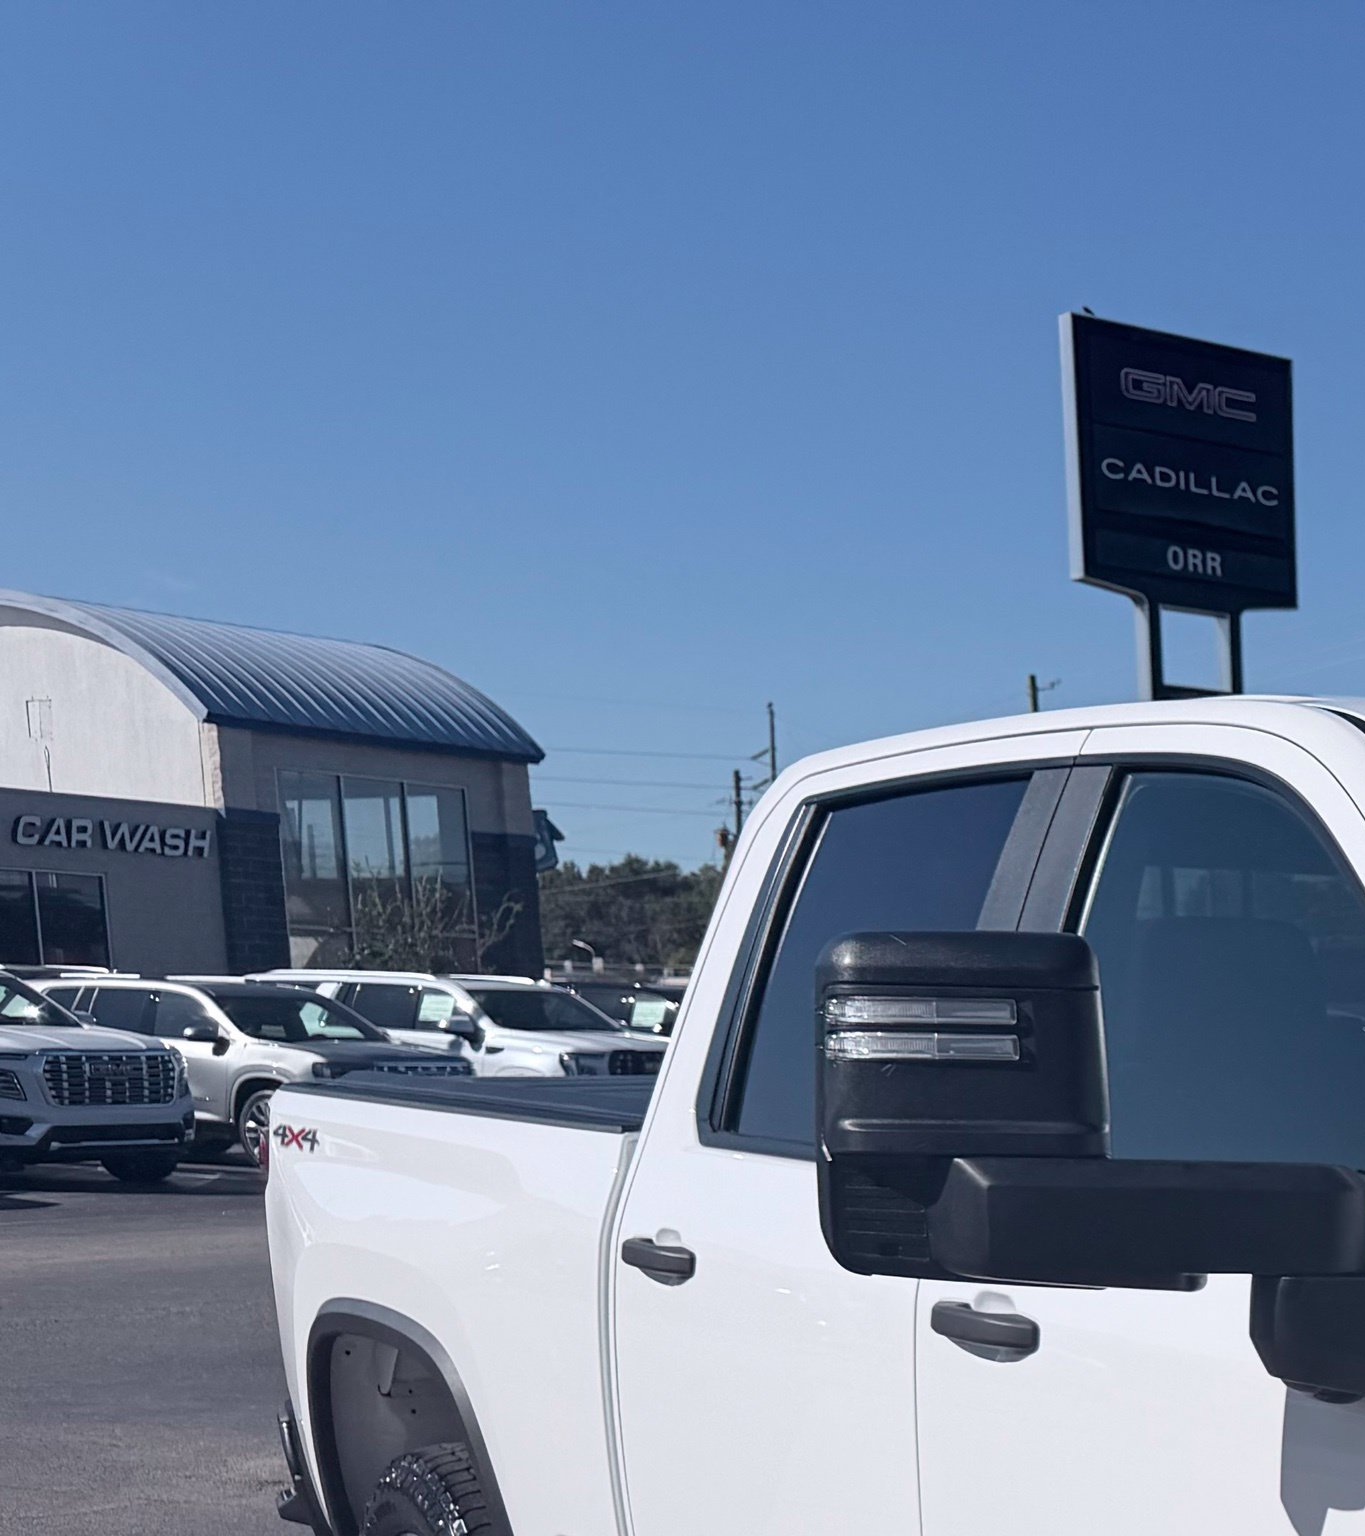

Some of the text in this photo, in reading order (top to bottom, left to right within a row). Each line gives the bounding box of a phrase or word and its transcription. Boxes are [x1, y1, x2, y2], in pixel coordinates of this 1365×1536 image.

[1120, 367, 1257, 423] GMC
[1101, 457, 1280, 507] CADILLAC
[1166, 545, 1223, 578] ORR
[15, 814, 212, 859] CAR WASH
